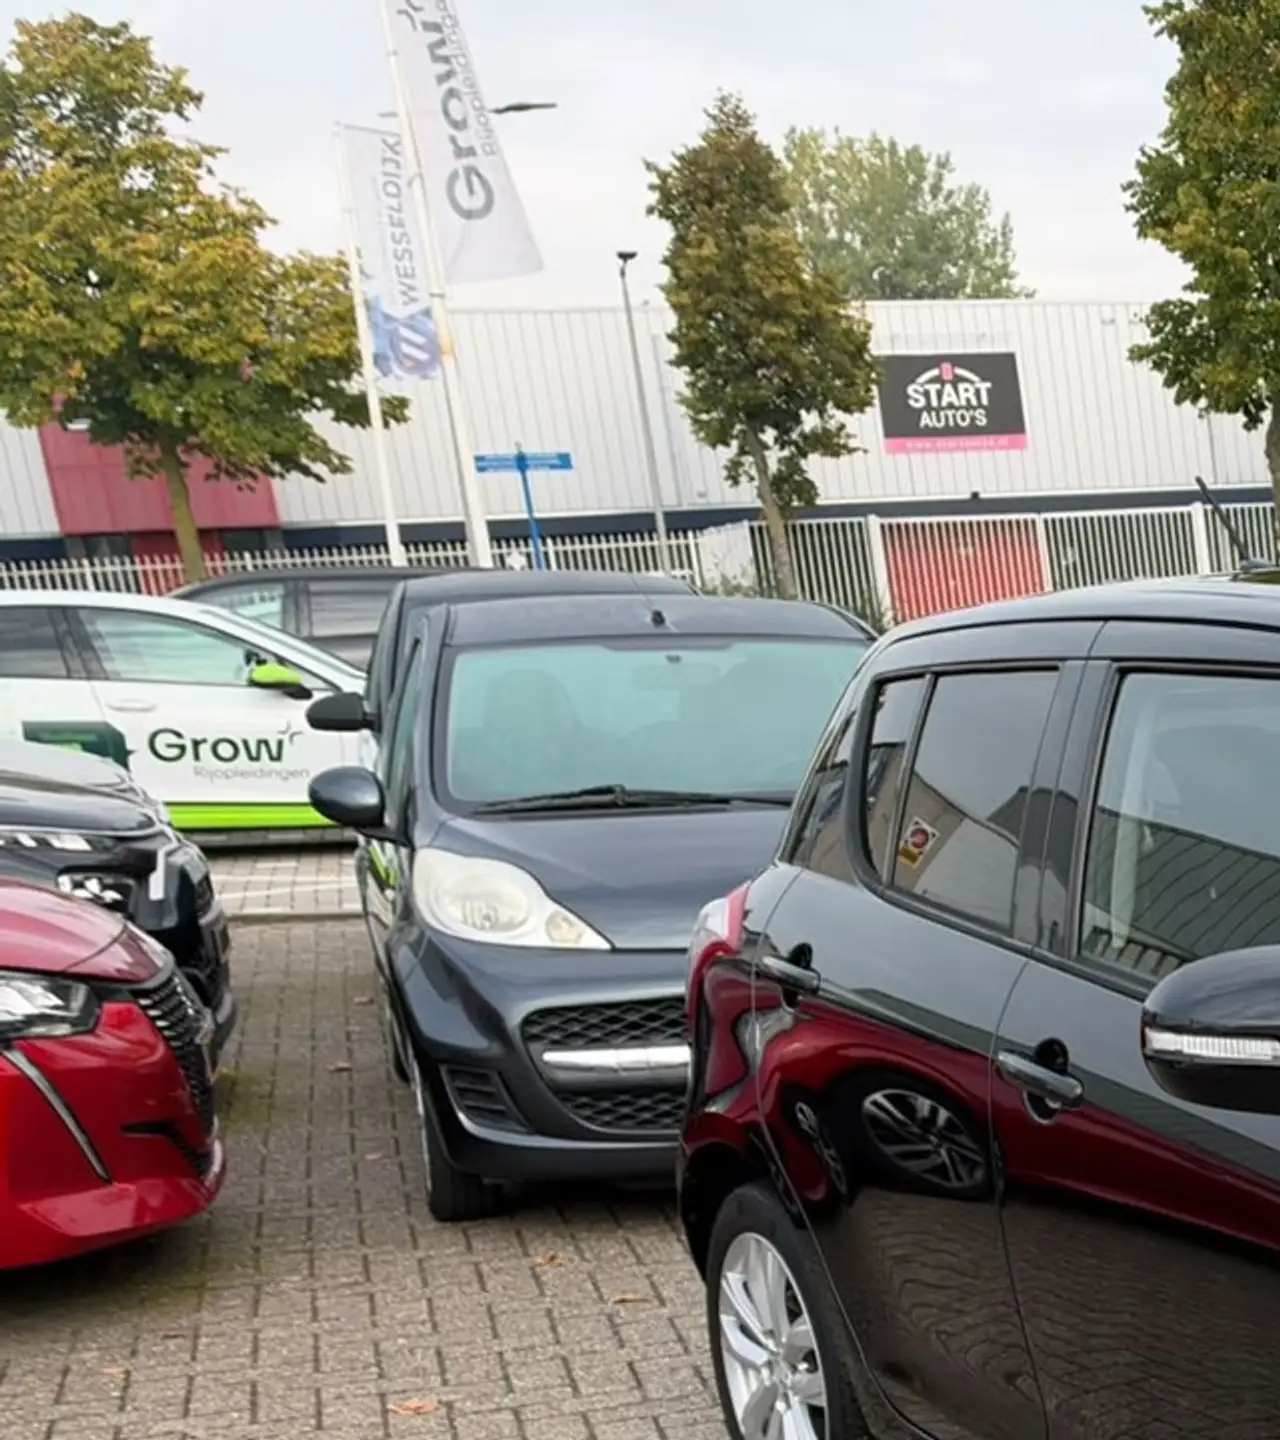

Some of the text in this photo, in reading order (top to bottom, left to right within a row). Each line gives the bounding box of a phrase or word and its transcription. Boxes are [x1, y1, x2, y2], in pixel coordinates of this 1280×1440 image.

[421, 21, 494, 220] Grow
[381, 137, 420, 306] WESSELDIJK
[906, 381, 992, 409] START
[919, 408, 988, 428] AUTO'S
[148, 728, 284, 762] Grow
[193, 765, 310, 783] Rijopleidingen
